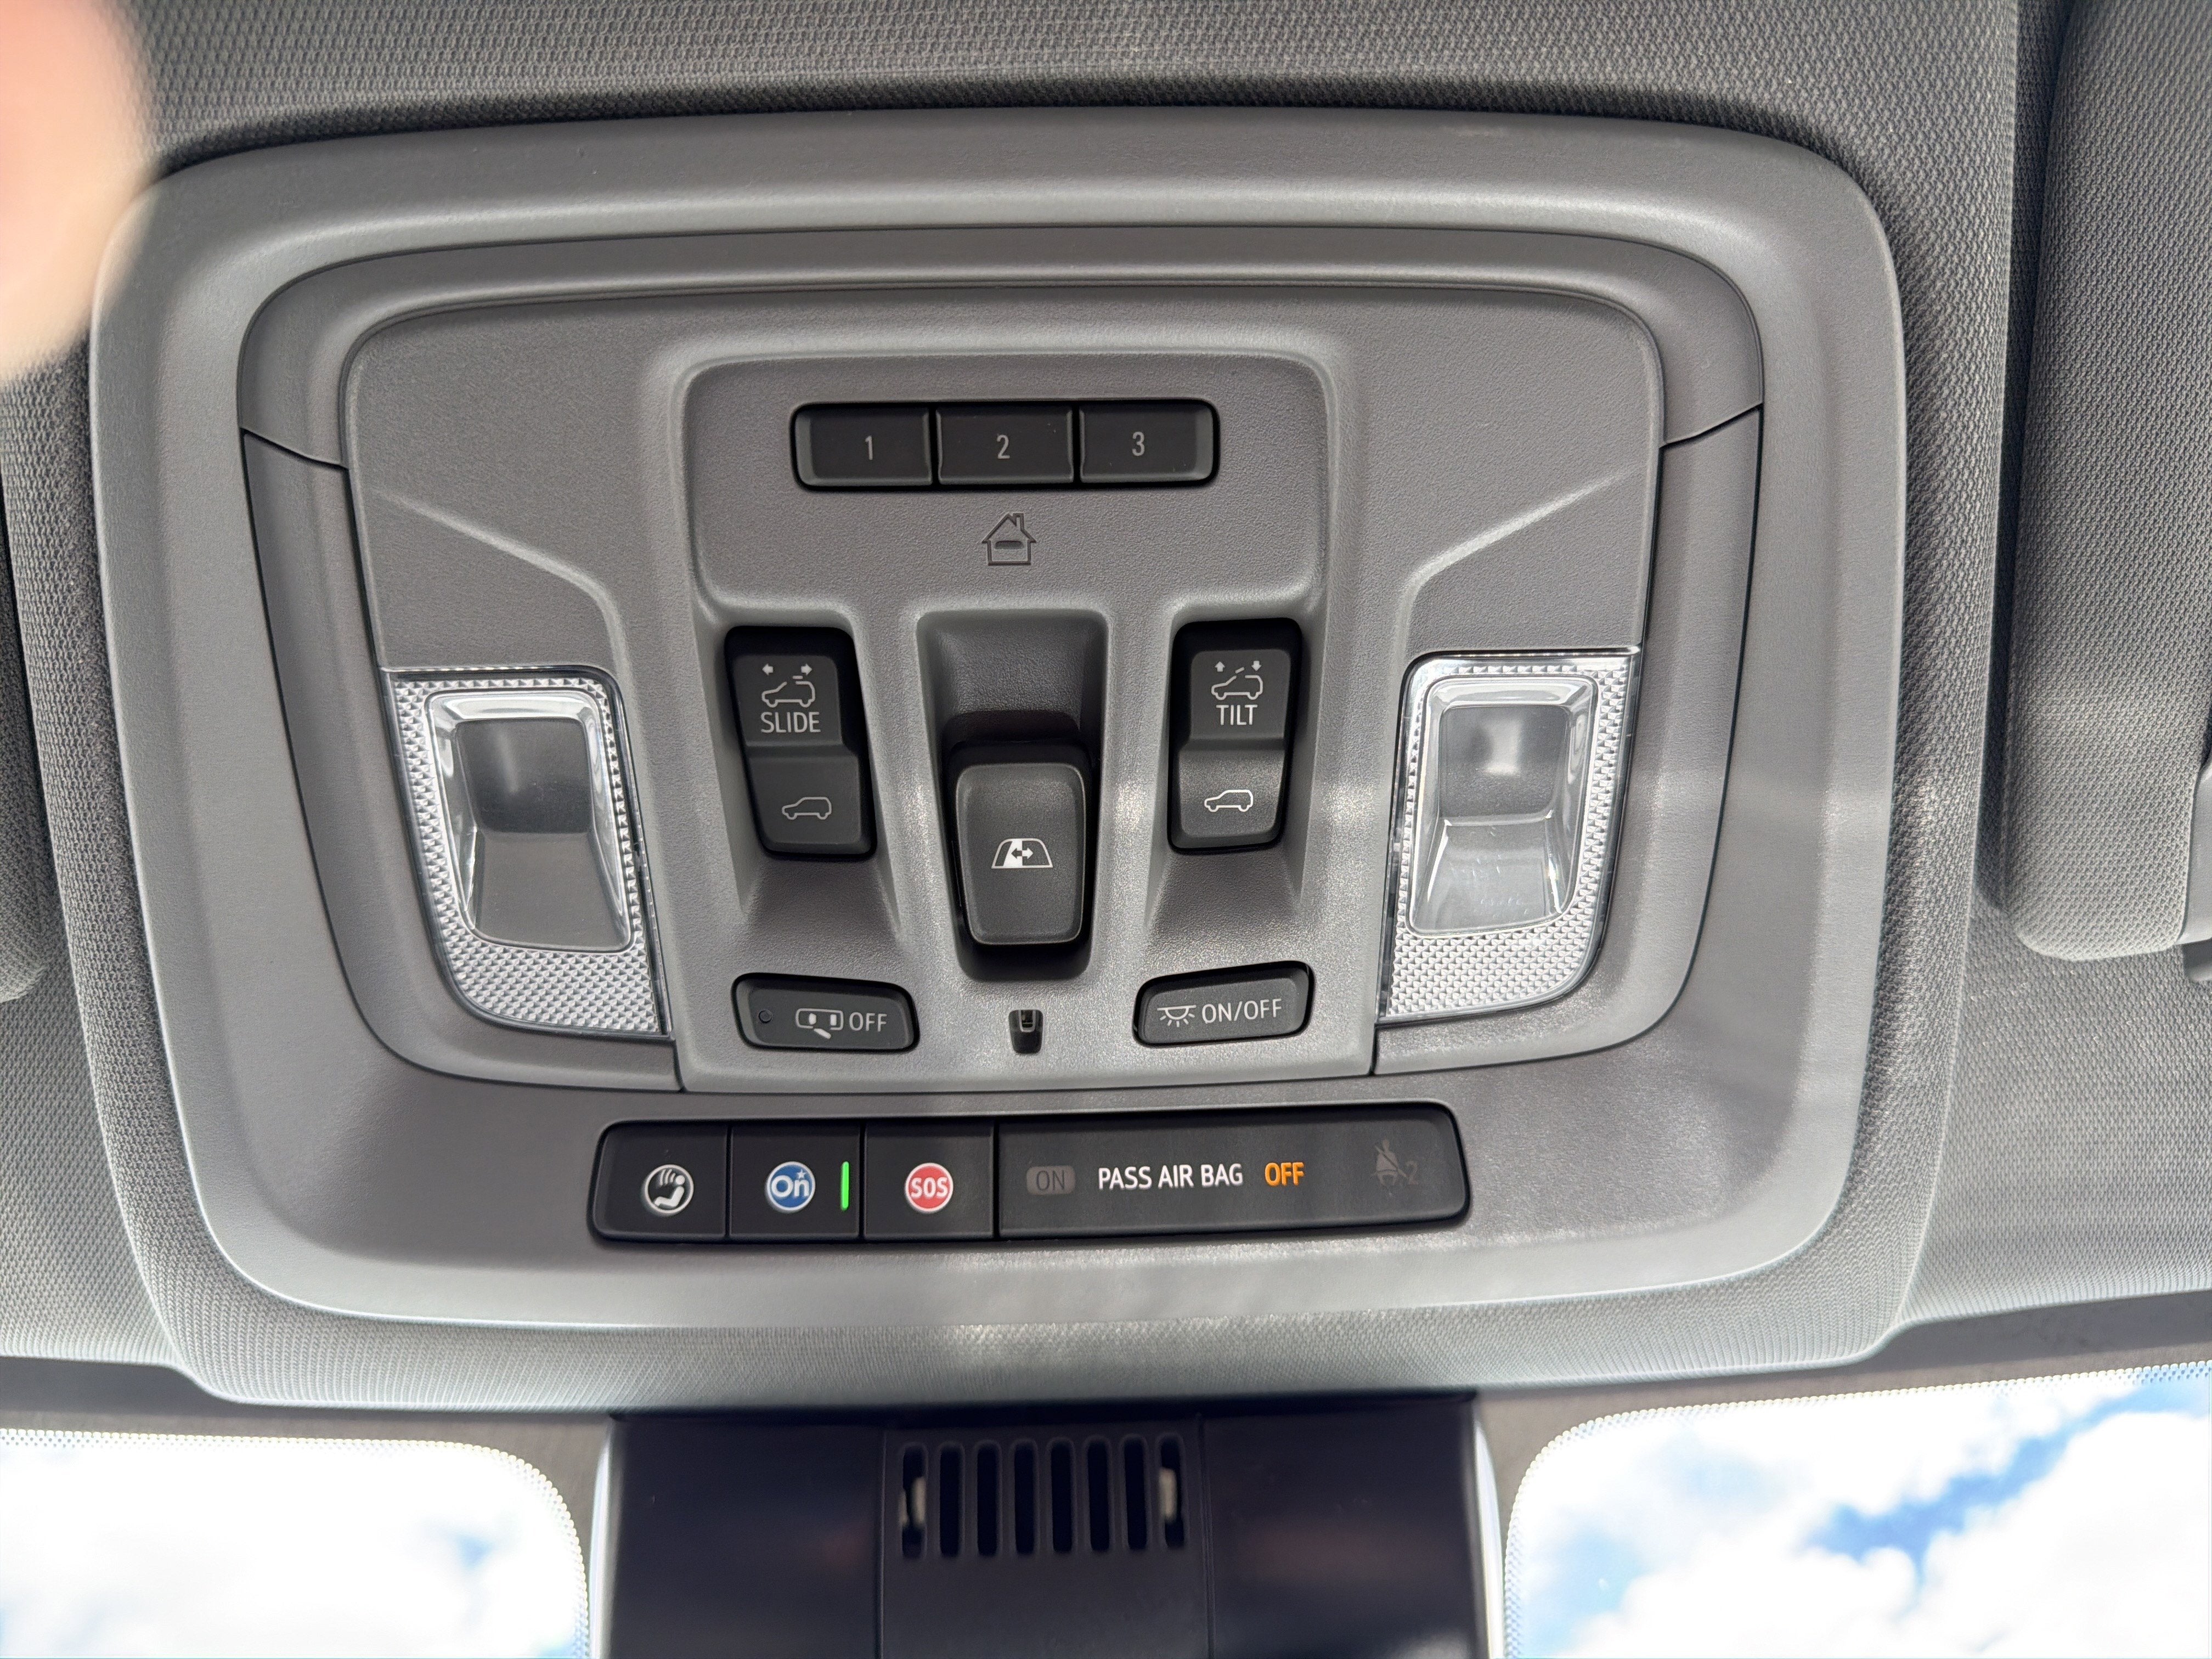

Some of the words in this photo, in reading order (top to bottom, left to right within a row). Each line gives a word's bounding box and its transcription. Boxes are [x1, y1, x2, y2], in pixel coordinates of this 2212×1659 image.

[864, 435, 874, 460] 1
[996, 434, 1011, 460] 2
[1131, 431, 1146, 456] 3
[760, 712, 821, 733] SLIDE
[1216, 704, 1258, 726] TILT
[849, 1012, 888, 1032] OFF
[1201, 998, 1282, 1024] ON/OFF
[771, 1175, 810, 1198] On
[911, 1176, 949, 1199] SOS
[1036, 1170, 1065, 1191] ON
[1098, 1166, 1152, 1190] PASS
[1158, 1164, 1194, 1189] AIR
[1200, 1163, 1243, 1187] BAG
[1265, 1161, 1305, 1187] OFF
